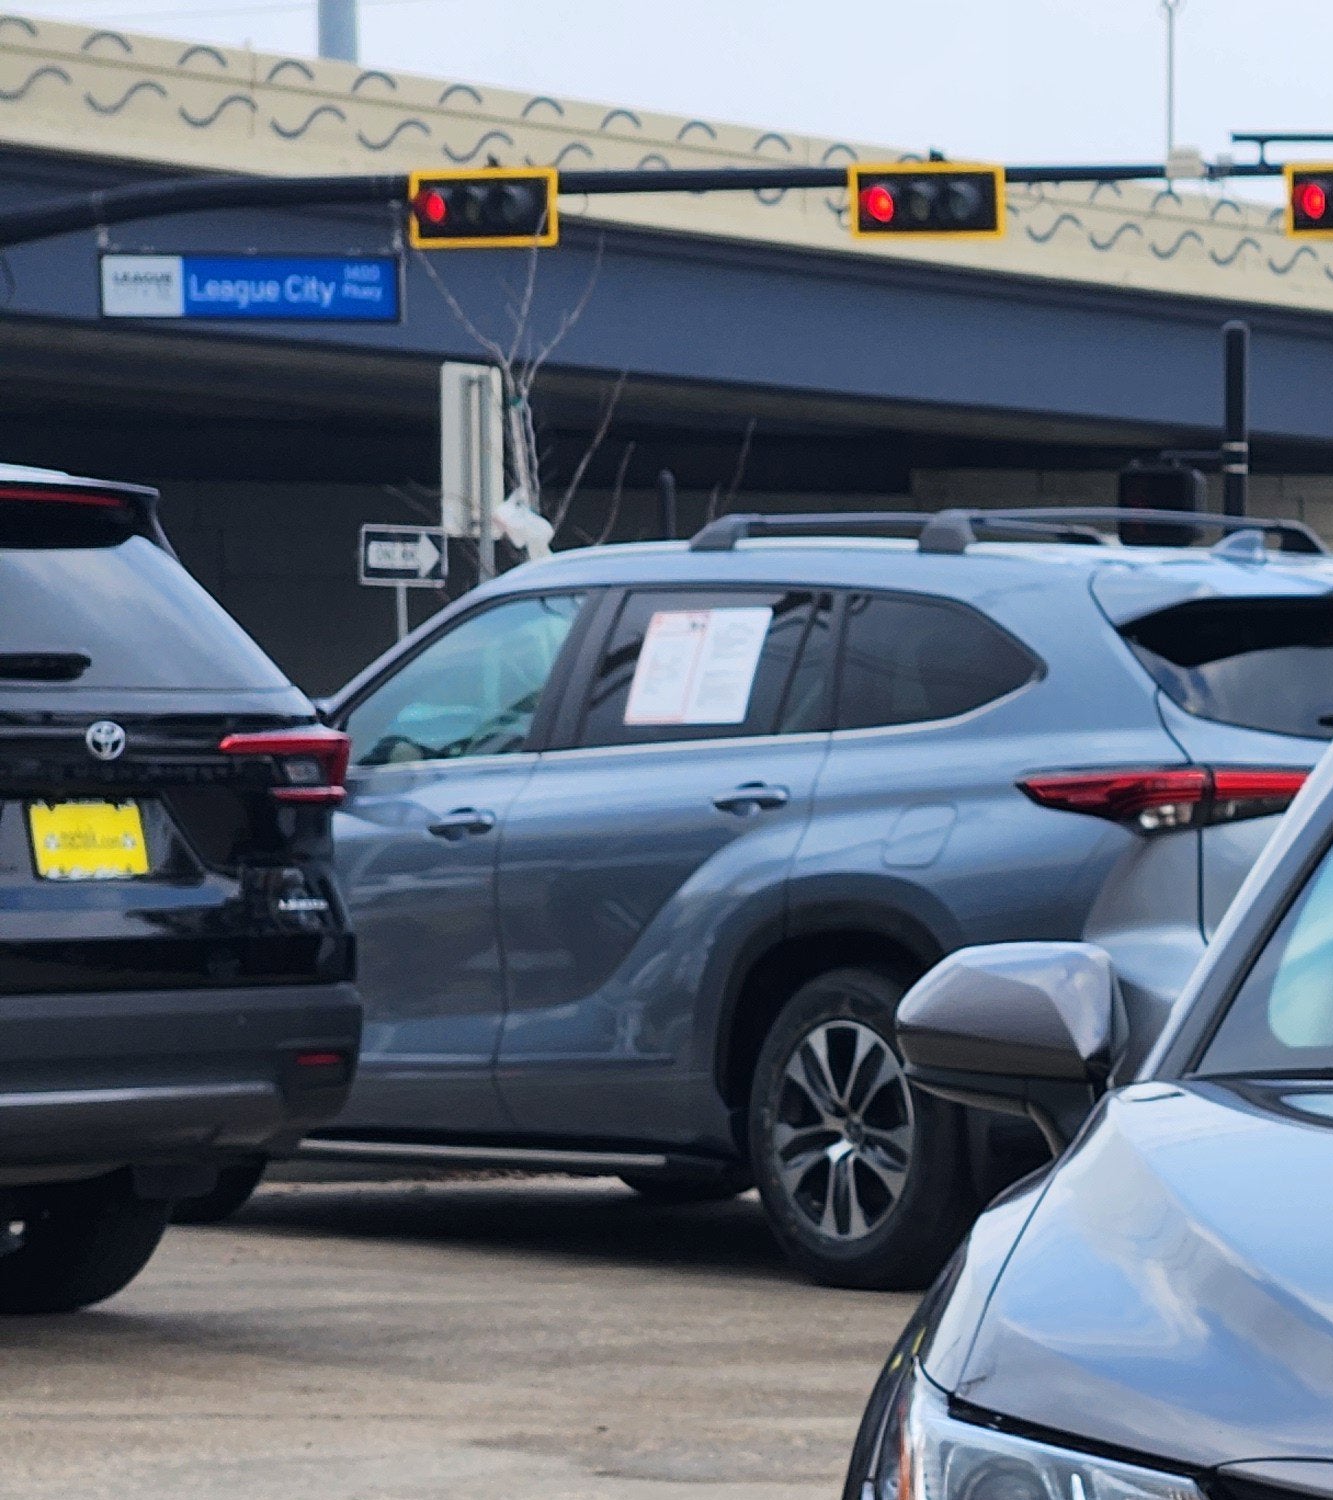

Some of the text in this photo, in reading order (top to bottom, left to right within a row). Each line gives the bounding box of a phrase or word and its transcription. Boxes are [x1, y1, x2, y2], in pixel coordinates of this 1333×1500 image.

[112, 271, 174, 285] LEAGUE
[189, 273, 281, 309] League
[283, 275, 336, 308] City
